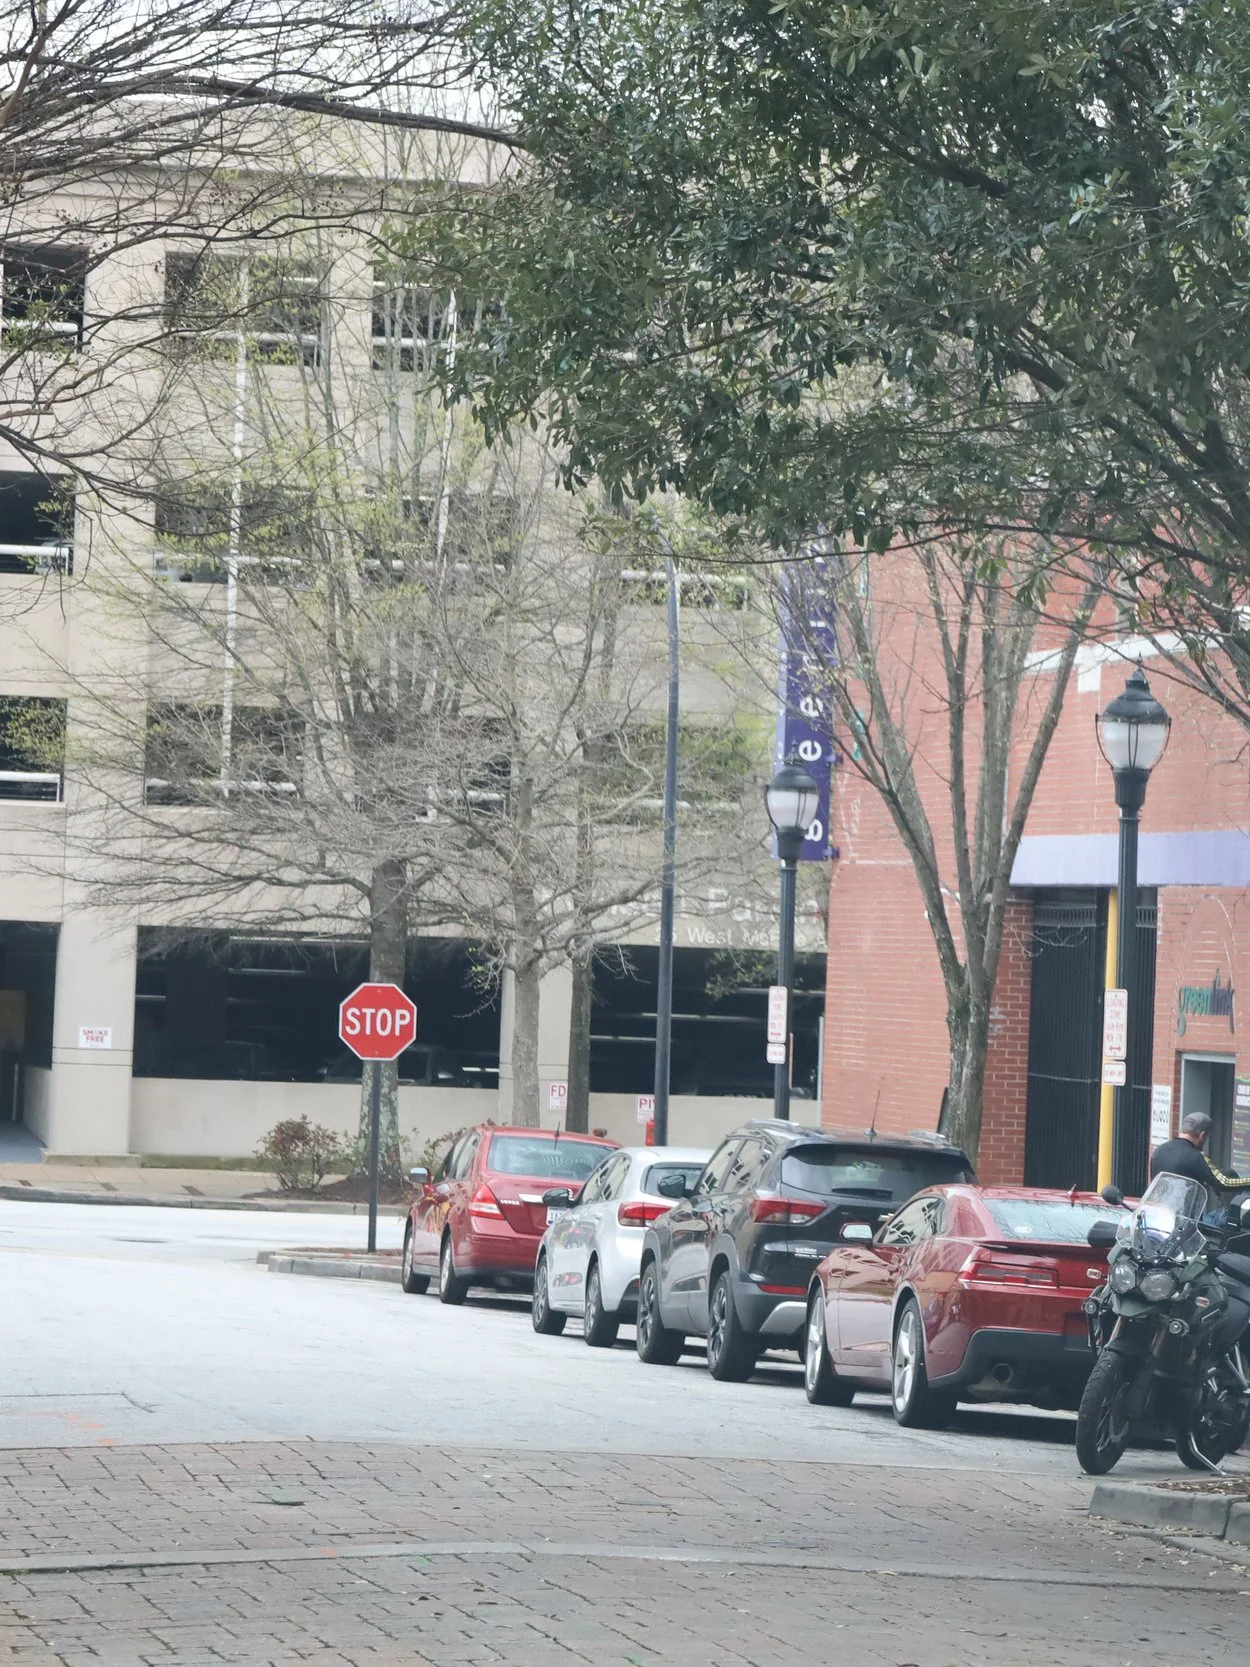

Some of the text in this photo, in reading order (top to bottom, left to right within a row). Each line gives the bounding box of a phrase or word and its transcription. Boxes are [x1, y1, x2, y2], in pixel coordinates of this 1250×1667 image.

[687, 927, 732, 946] West
[1173, 968, 1236, 1037] greenlink
[345, 1007, 411, 1037] STOP
[639, 1098, 656, 1109] PI
